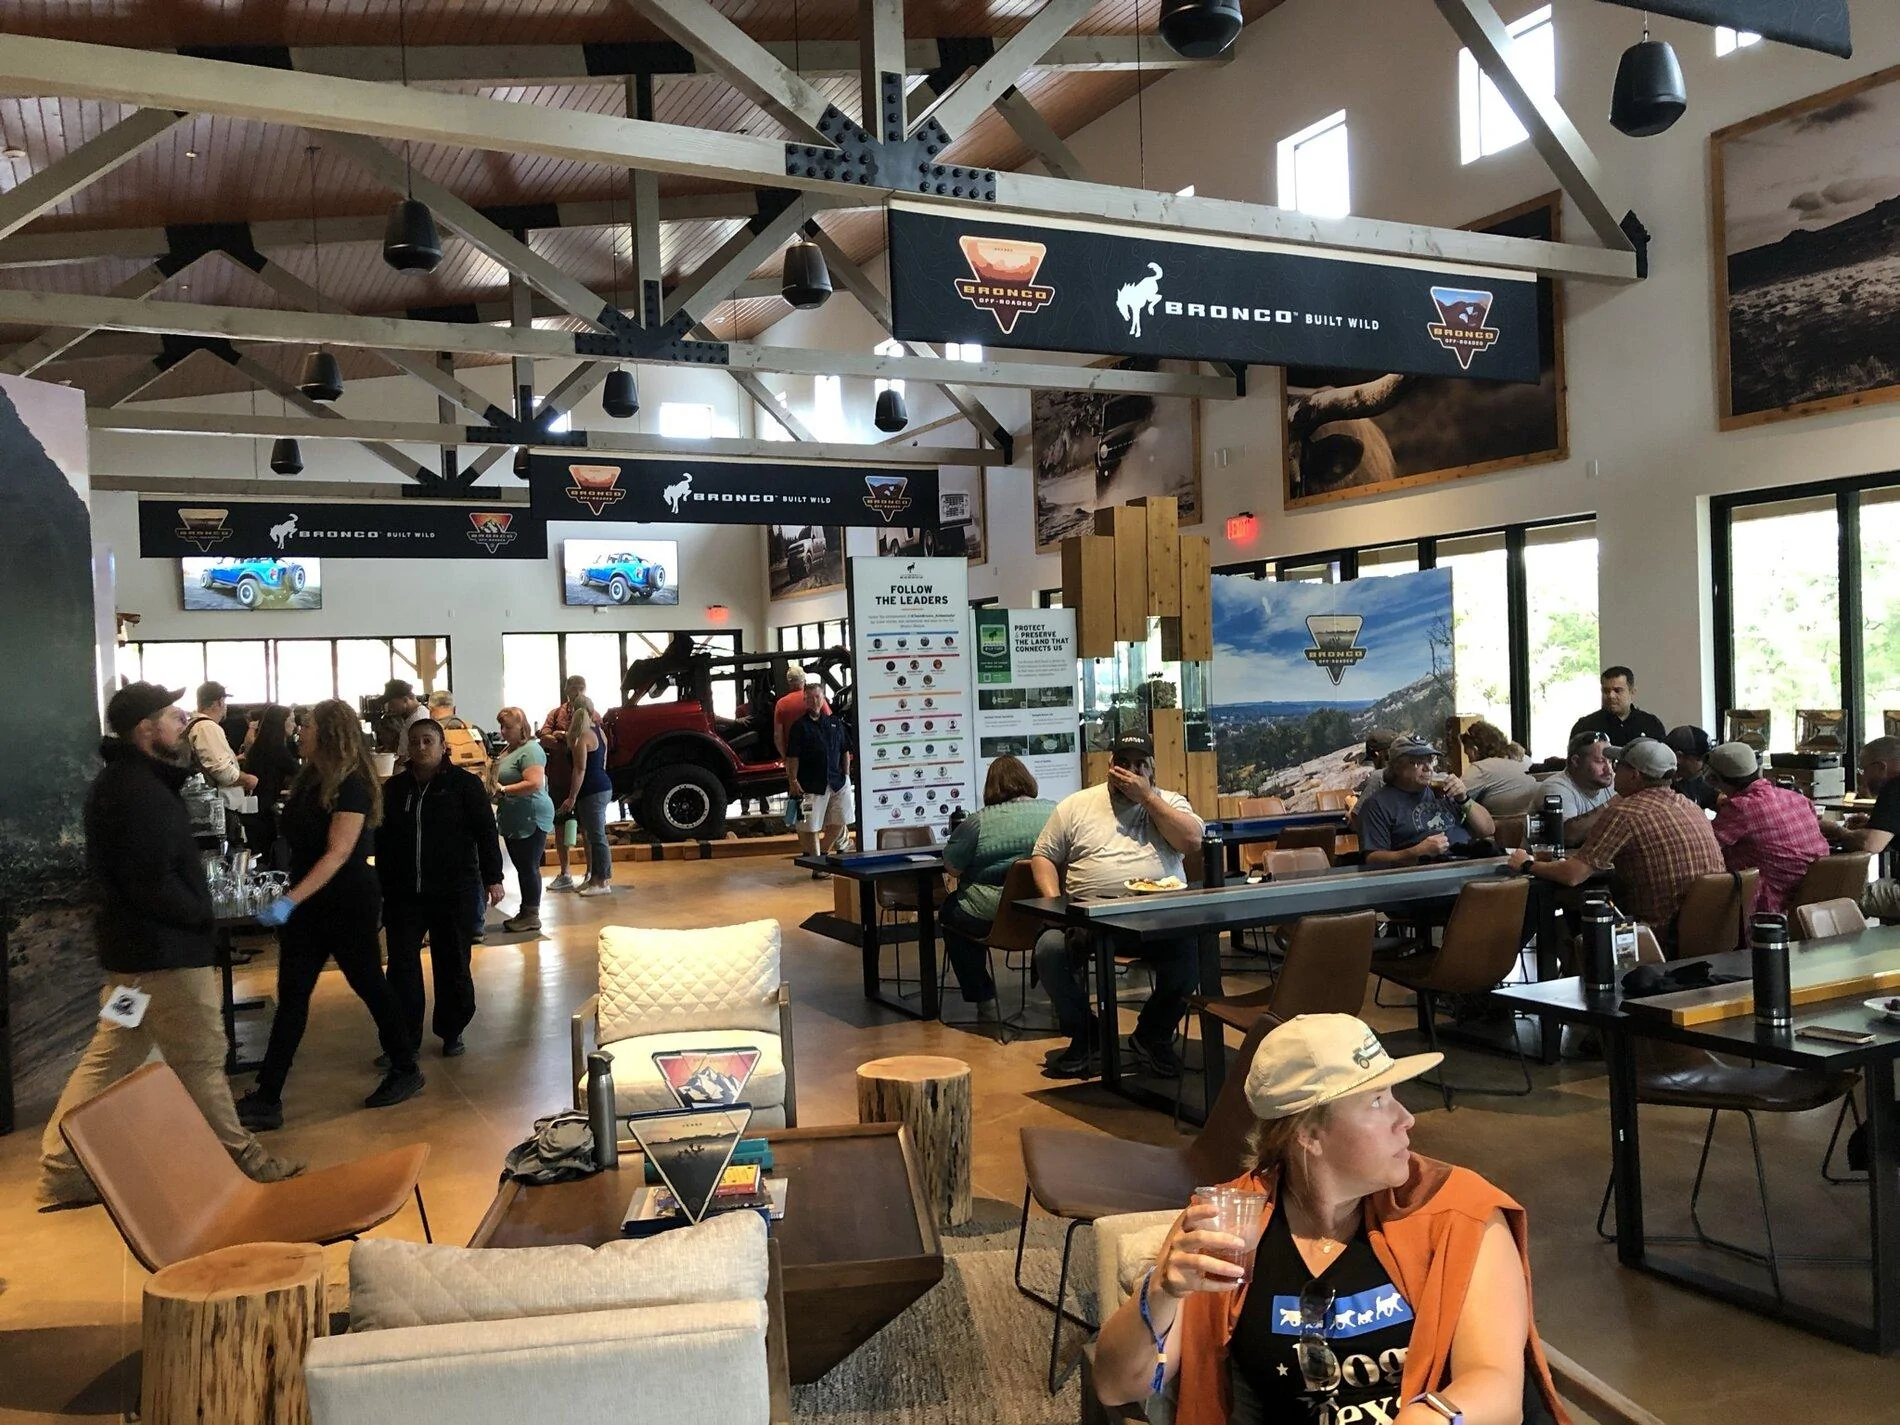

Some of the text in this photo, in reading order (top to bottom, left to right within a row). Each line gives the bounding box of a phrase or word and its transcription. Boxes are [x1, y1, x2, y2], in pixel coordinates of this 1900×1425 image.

[963, 285, 1047, 300] BRONCO
[1165, 300, 1380, 331] BRONCO BUILT WILD
[1433, 328, 1494, 339] BRONCO
[693, 493, 775, 503] BRONCO
[299, 530, 379, 538] BRONCO
[890, 585, 933, 594] FOLLOW
[875, 595, 949, 605] THE LEADERS
[1015, 638, 1029, 646] THE
